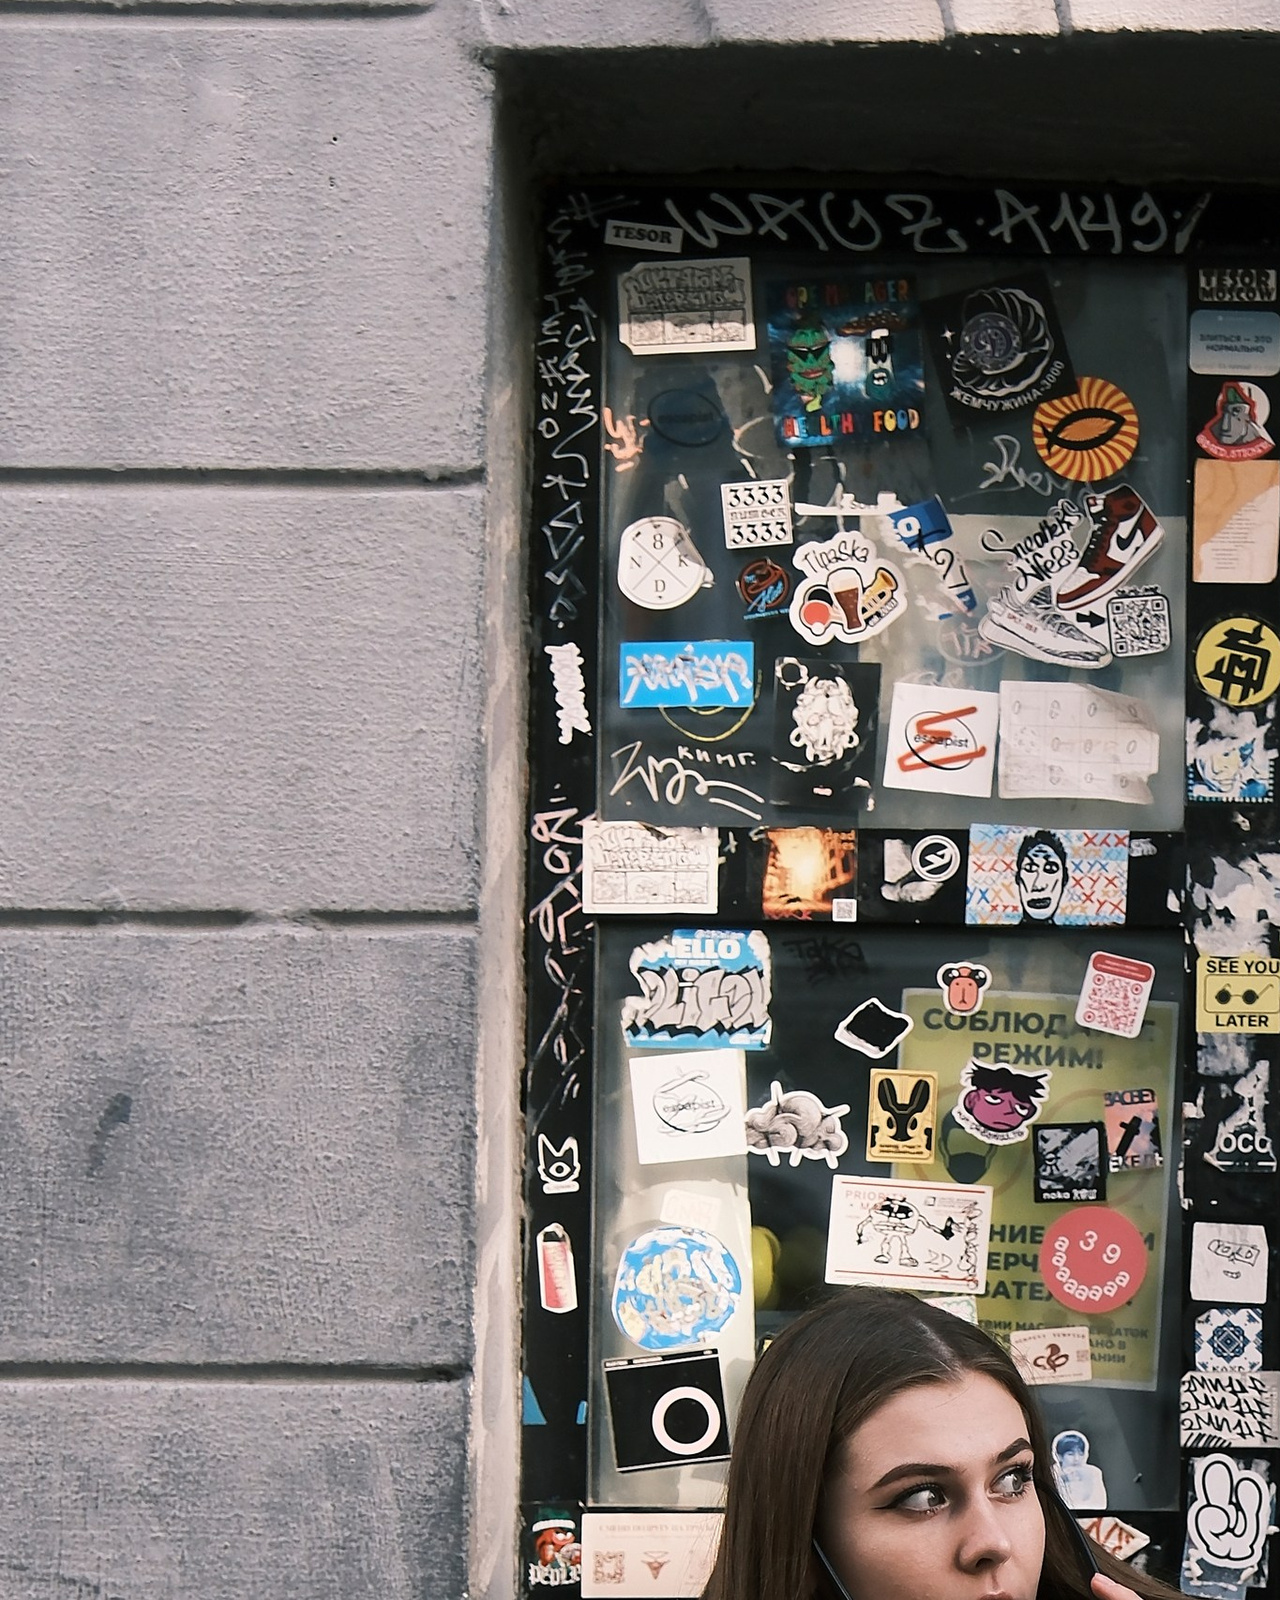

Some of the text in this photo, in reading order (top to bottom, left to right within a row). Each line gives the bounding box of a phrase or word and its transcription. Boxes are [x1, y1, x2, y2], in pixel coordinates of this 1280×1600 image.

[612, 225, 672, 245] TESOR
[1206, 960, 1280, 974] SEE YOU
[1215, 1014, 1269, 1028] LATER
